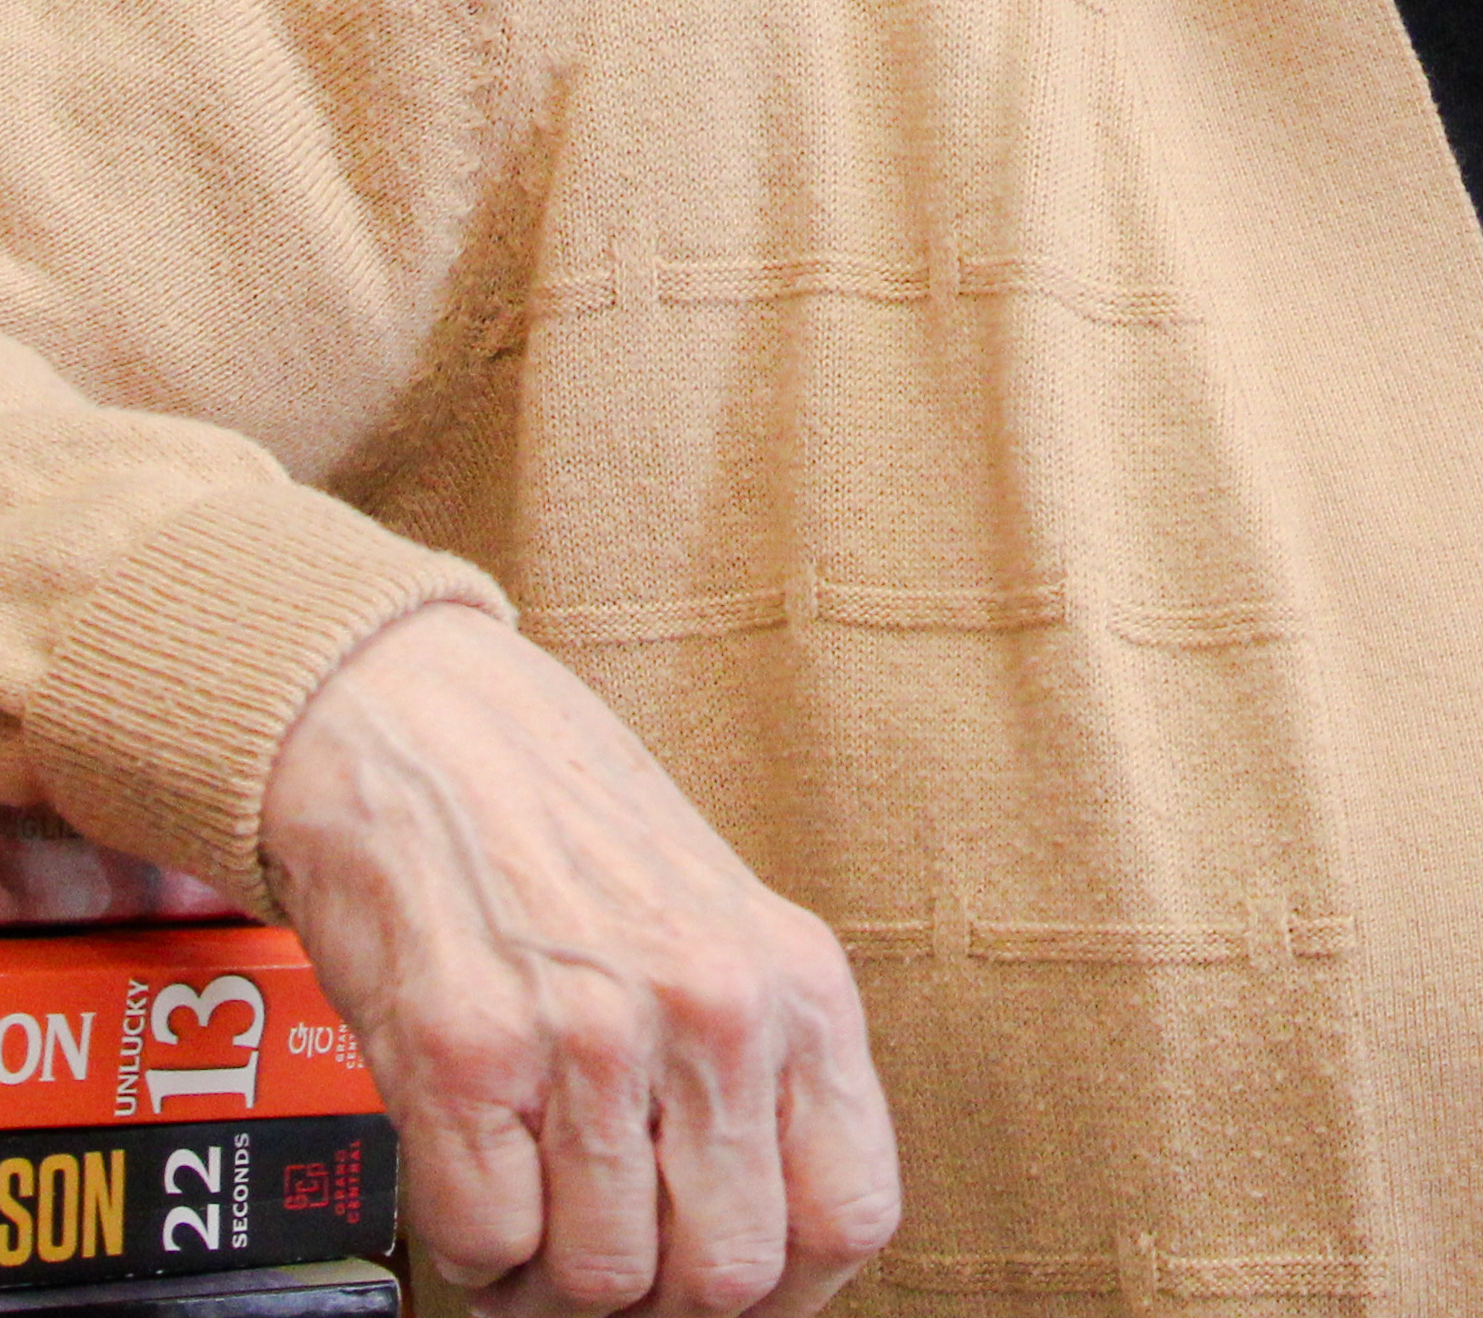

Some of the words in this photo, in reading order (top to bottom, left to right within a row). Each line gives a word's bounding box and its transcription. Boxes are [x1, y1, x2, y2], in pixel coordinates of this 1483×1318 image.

[113, 977, 150, 1118] UNLUCKY
[144, 973, 267, 1115] 13
[161, 1145, 223, 1255] 22
[230, 1132, 251, 1250] SECONDS
